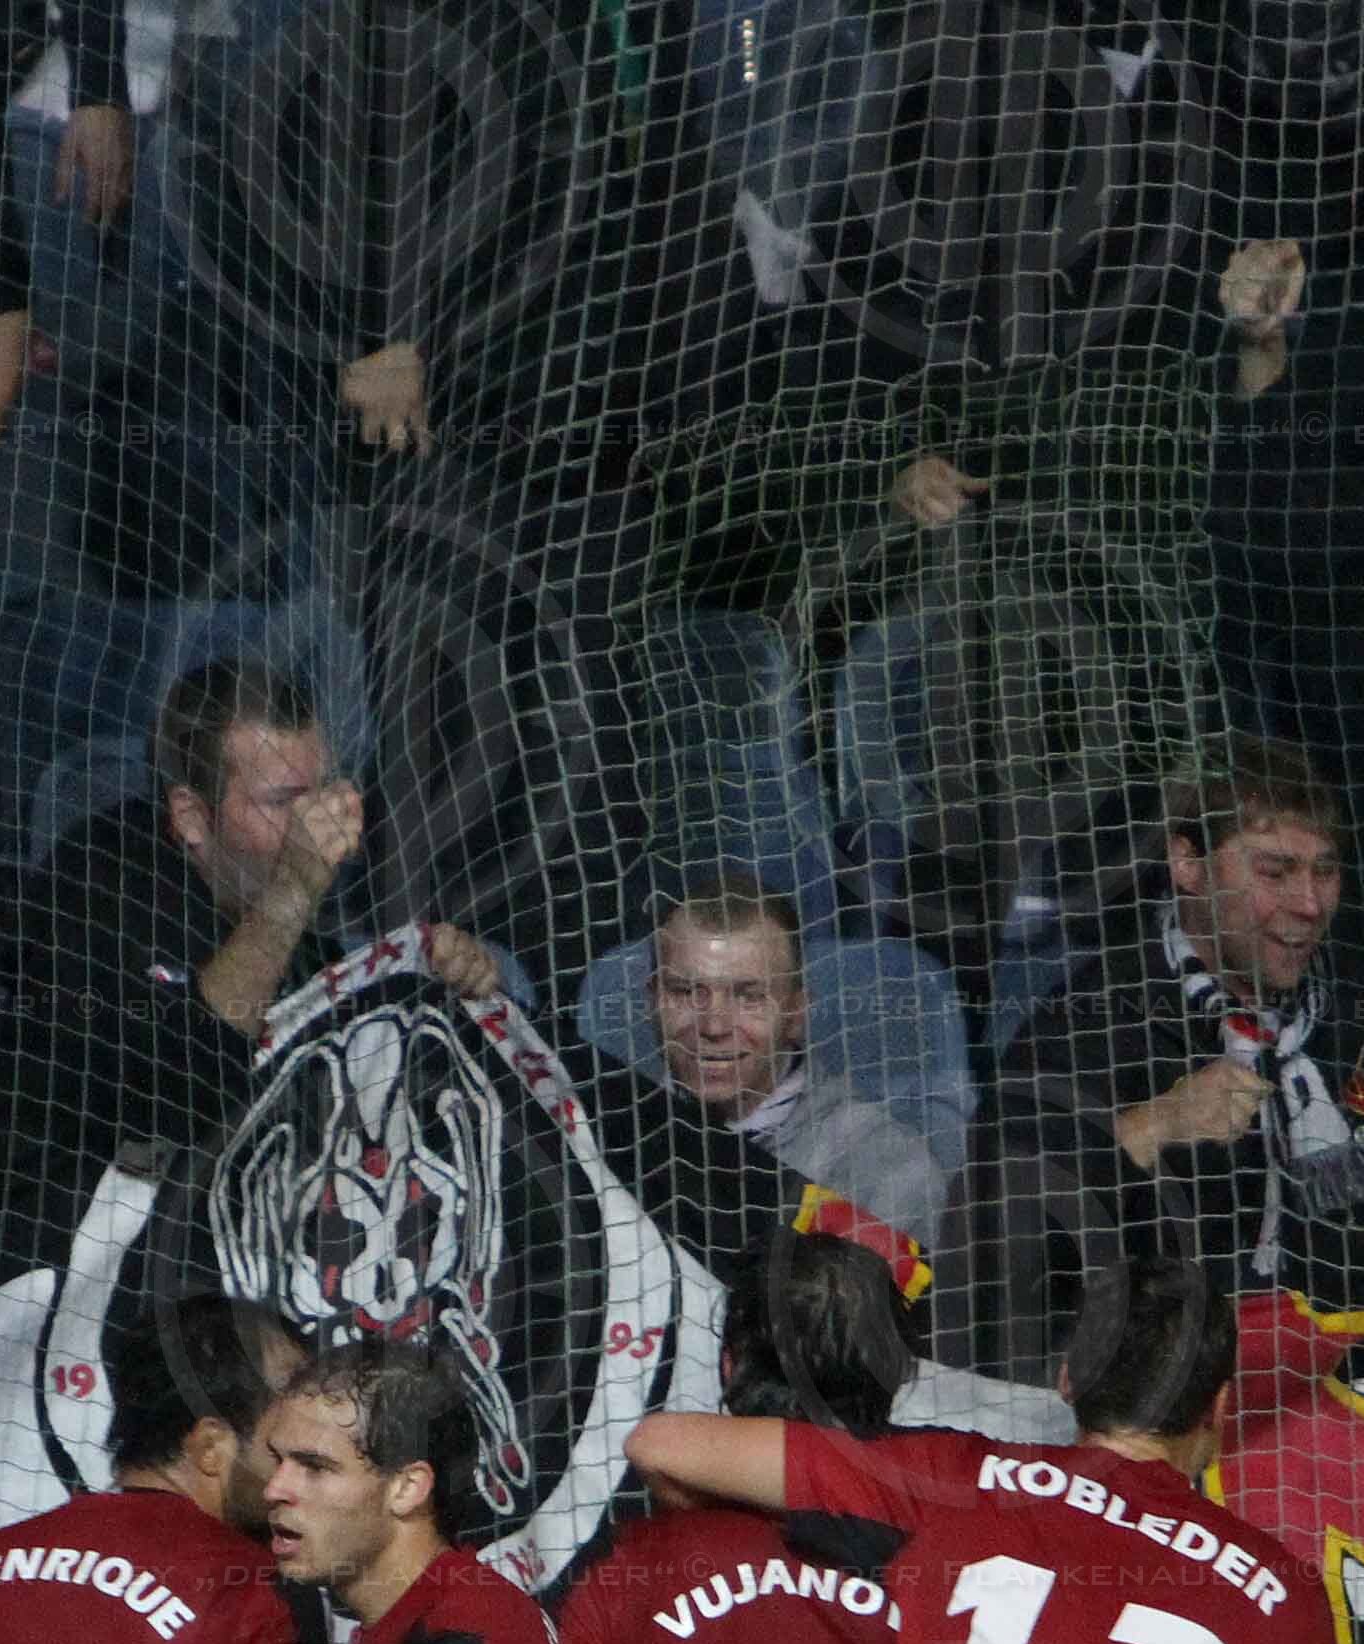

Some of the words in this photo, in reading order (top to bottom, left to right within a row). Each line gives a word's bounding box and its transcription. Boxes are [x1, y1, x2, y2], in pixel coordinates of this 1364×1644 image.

[604, 1322, 664, 1360] 95
[50, 1363, 96, 1398] 19
[977, 1453, 1289, 1616] KOBLEDER
